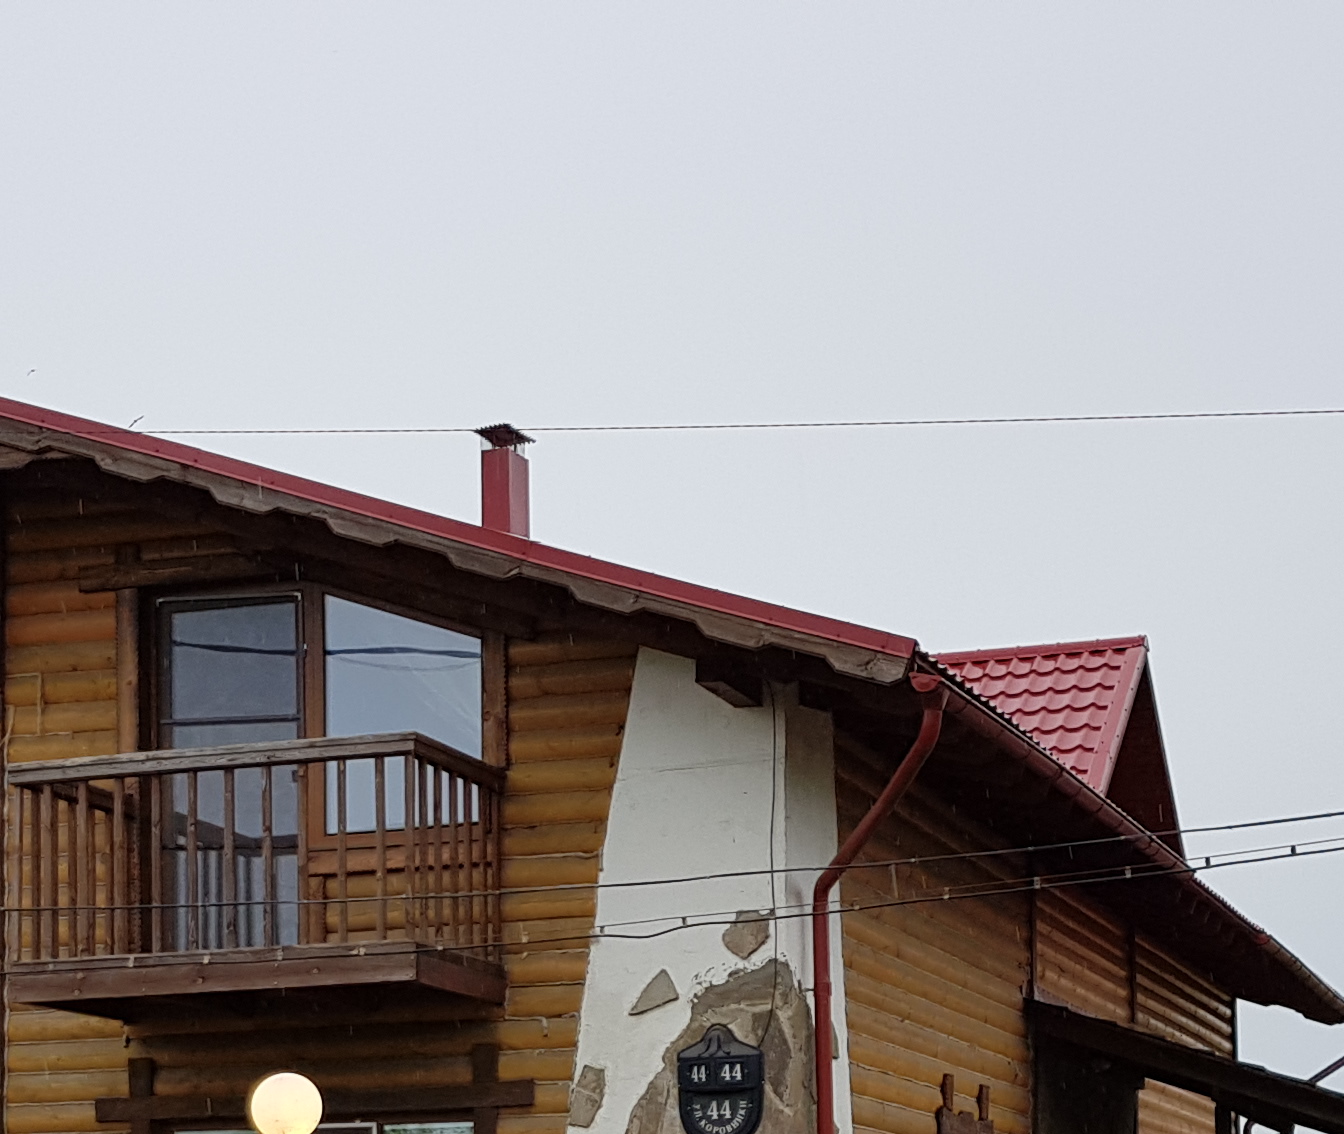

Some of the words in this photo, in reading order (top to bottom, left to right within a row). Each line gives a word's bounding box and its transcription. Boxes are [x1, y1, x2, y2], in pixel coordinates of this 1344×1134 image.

[691, 1065, 706, 1082] 44
[721, 1063, 742, 1081] 44
[707, 1100, 732, 1120] 44
